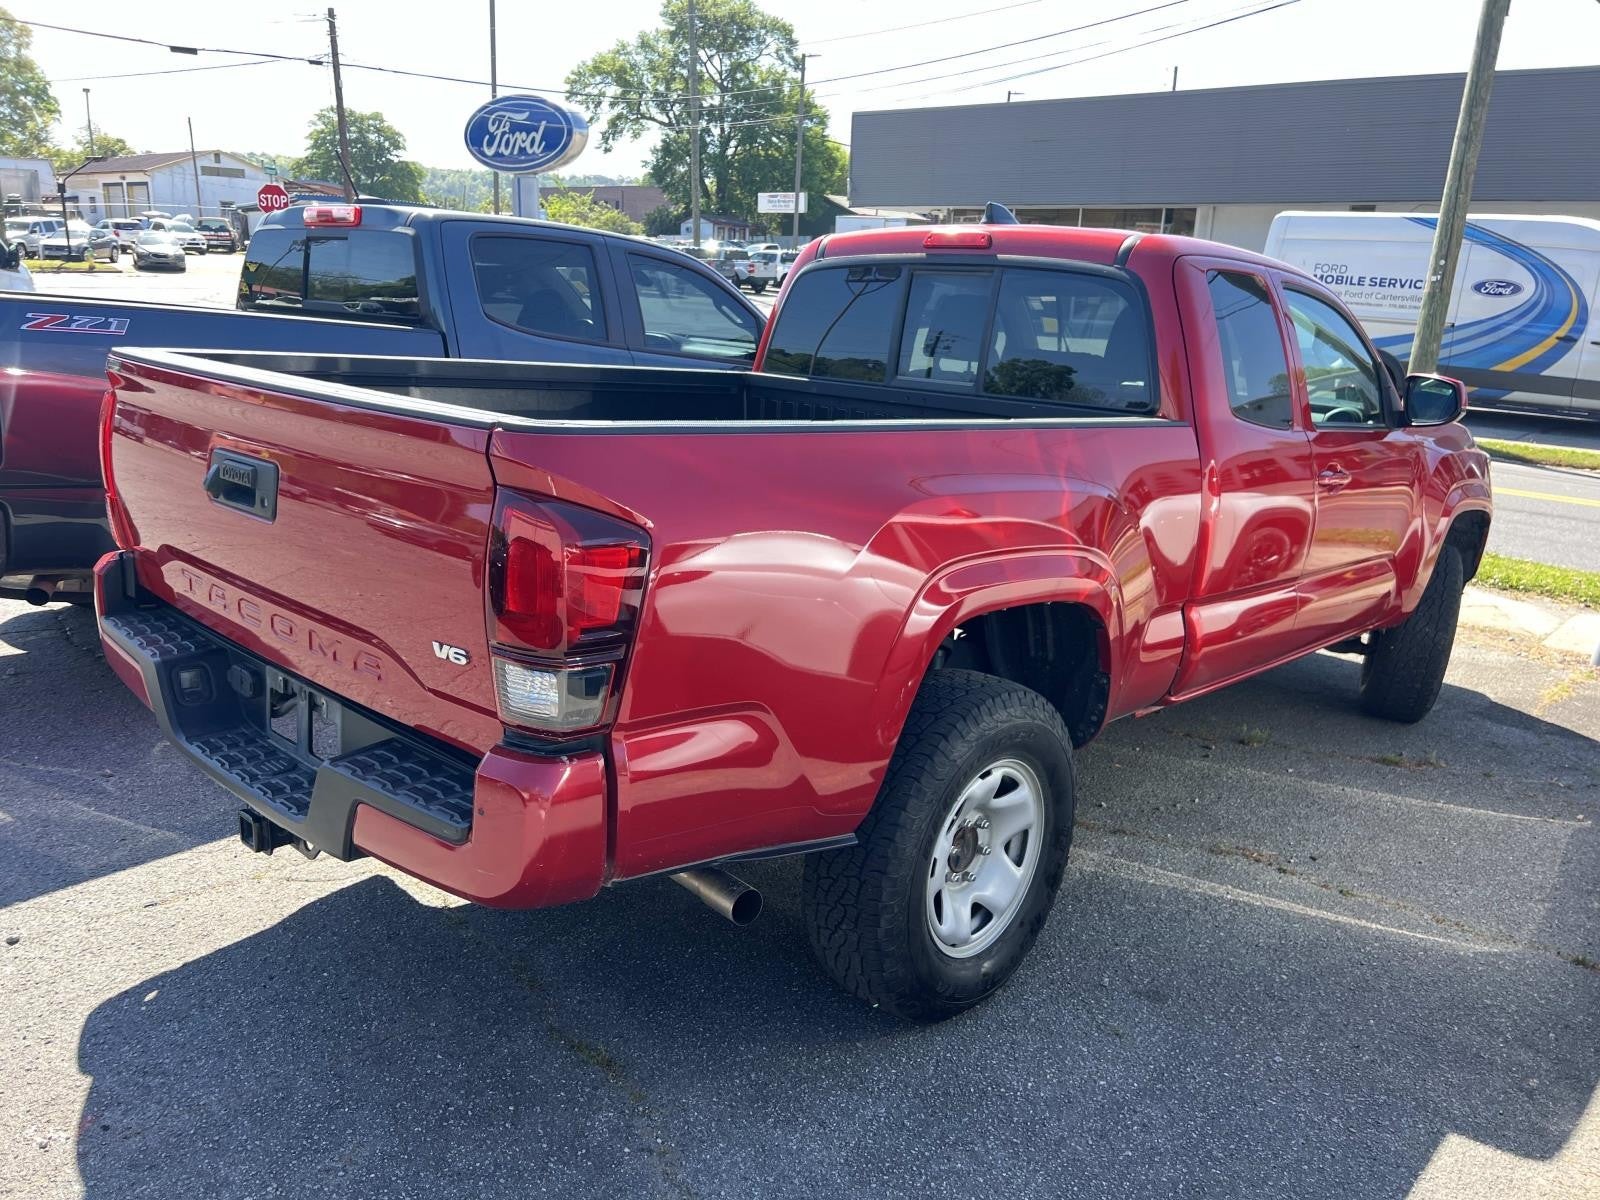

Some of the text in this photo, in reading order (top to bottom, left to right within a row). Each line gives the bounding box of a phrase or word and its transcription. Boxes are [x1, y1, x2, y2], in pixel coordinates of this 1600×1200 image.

[483, 111, 547, 156] Ford
[260, 194, 287, 207] STOP
[1314, 263, 1348, 274] FORD
[1368, 277, 1425, 290] SERVIC
[1481, 281, 1514, 295] Ford
[1344, 290, 1363, 299] Ford
[1365, 291, 1373, 299] of
[20, 312, 130, 335] Z71
[221, 464, 252, 485] TOYOTA
[181, 567, 383, 682] TACOMA
[432, 640, 470, 666] V6
